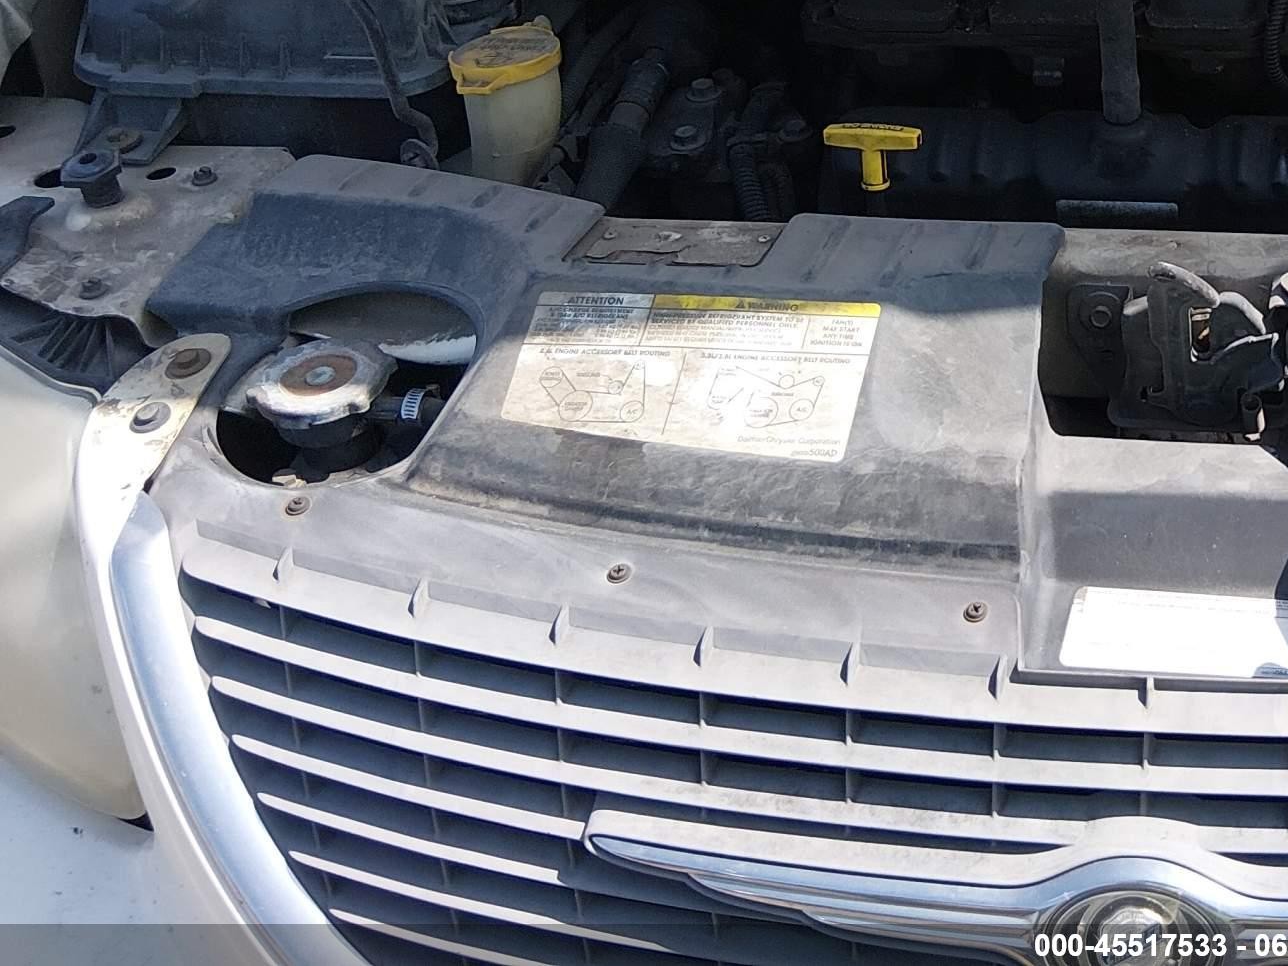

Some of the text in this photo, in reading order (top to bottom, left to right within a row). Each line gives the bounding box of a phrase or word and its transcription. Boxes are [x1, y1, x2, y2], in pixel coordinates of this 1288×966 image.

[568, 297, 625, 305] ATTENTION
[747, 301, 799, 311] WARNING
[736, 320, 777, 328] PERSONNEL
